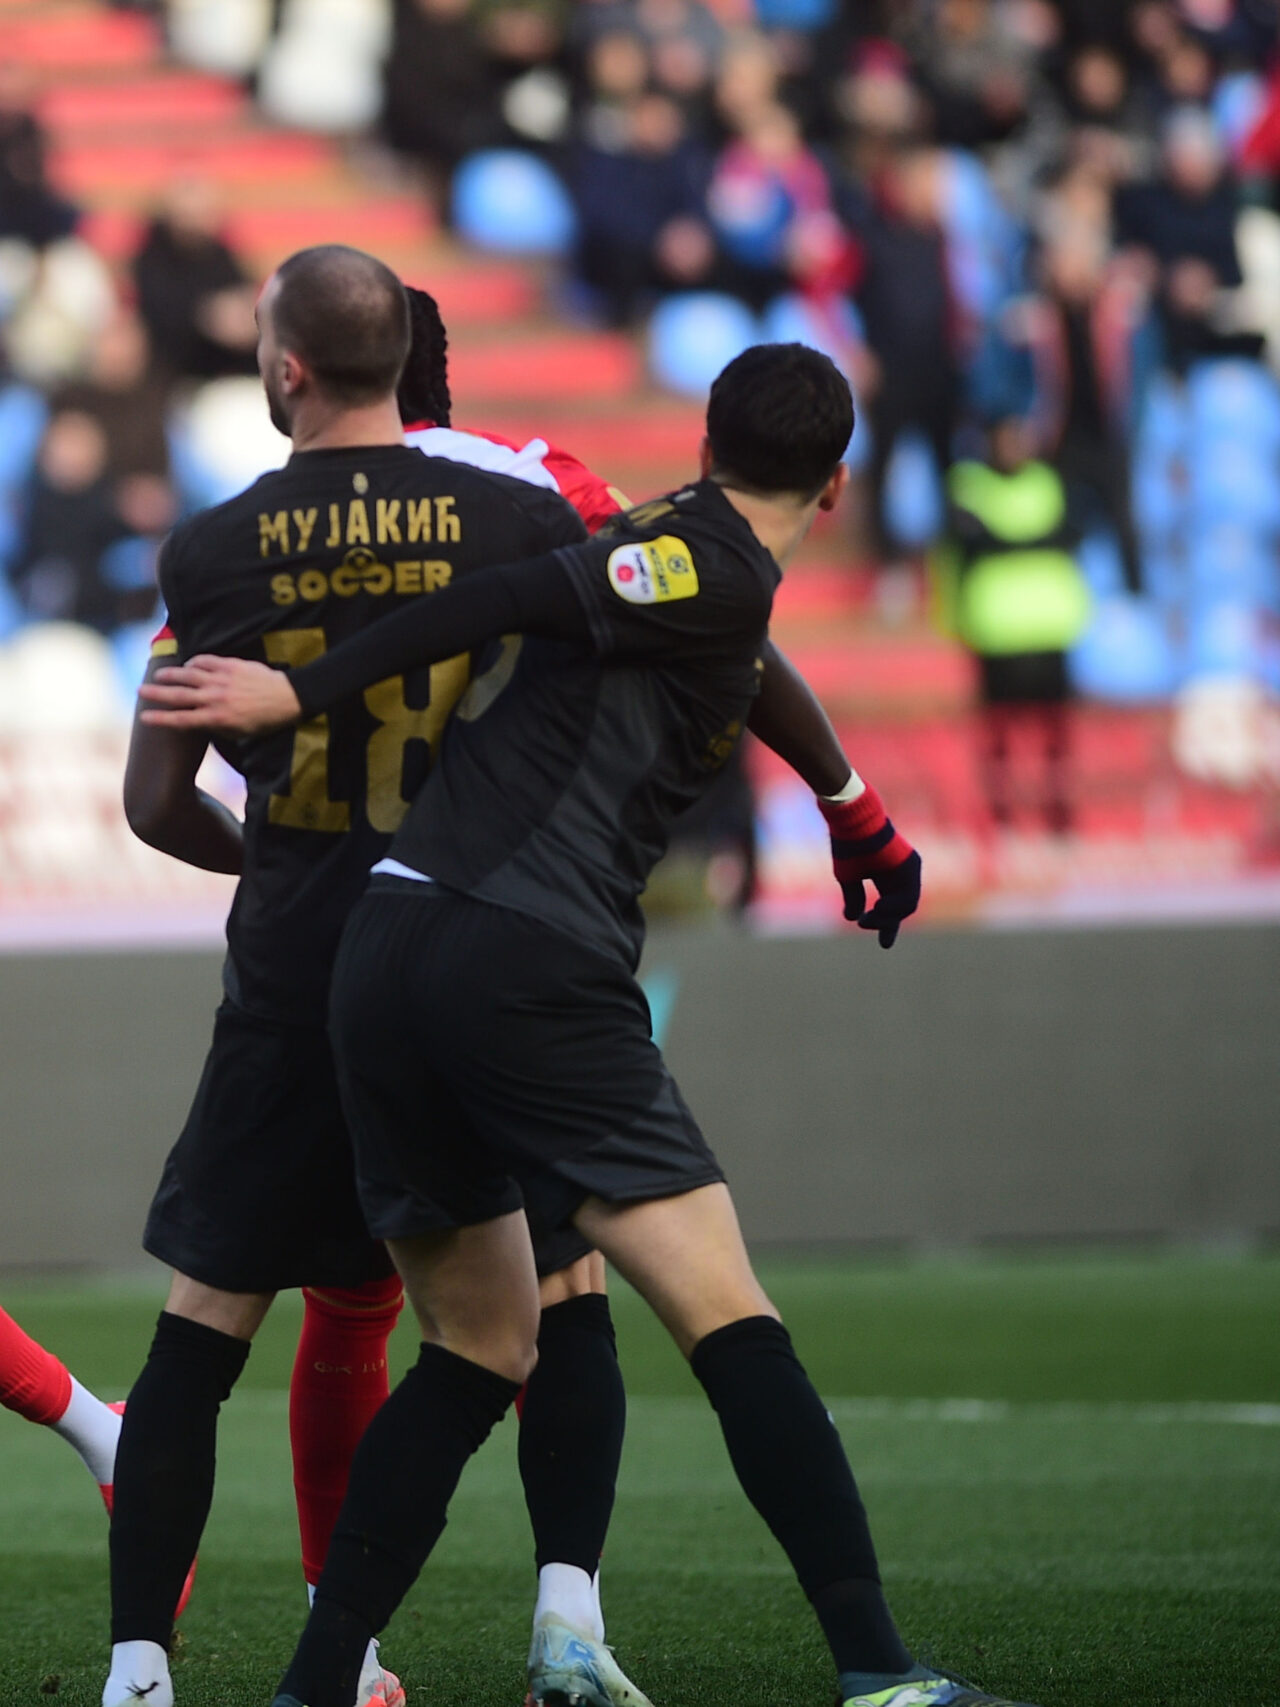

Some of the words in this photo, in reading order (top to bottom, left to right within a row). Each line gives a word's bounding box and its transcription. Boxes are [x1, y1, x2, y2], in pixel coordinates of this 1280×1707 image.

[258, 496, 461, 558] МУЈАКИЋ
[271, 558, 453, 606] SOCCER
[263, 627, 471, 834] 18
